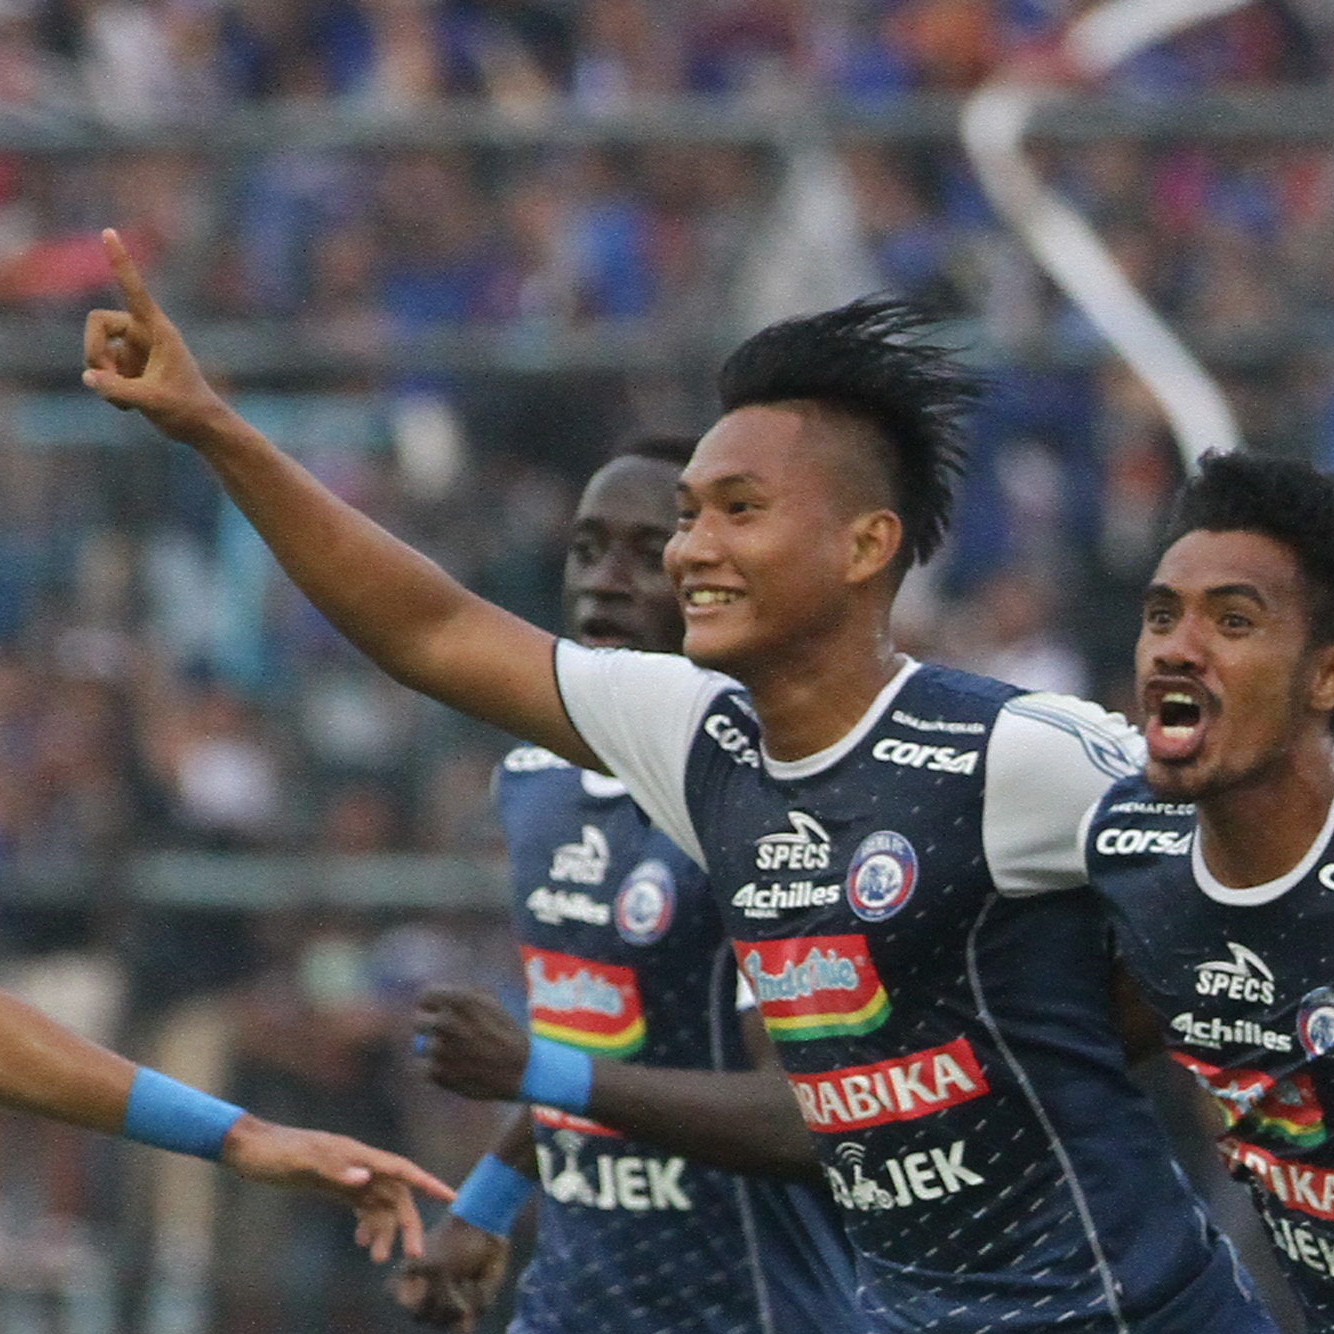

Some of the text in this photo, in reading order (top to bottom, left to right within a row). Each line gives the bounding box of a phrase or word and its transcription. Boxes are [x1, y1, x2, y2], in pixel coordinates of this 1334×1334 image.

[756, 843, 831, 870] SPECS
[731, 880, 842, 909] Achilles
[1195, 970, 1275, 1006] SPECS
[1170, 1012, 1293, 1052] Achilles
[795, 1053, 978, 1127] RABIKA
